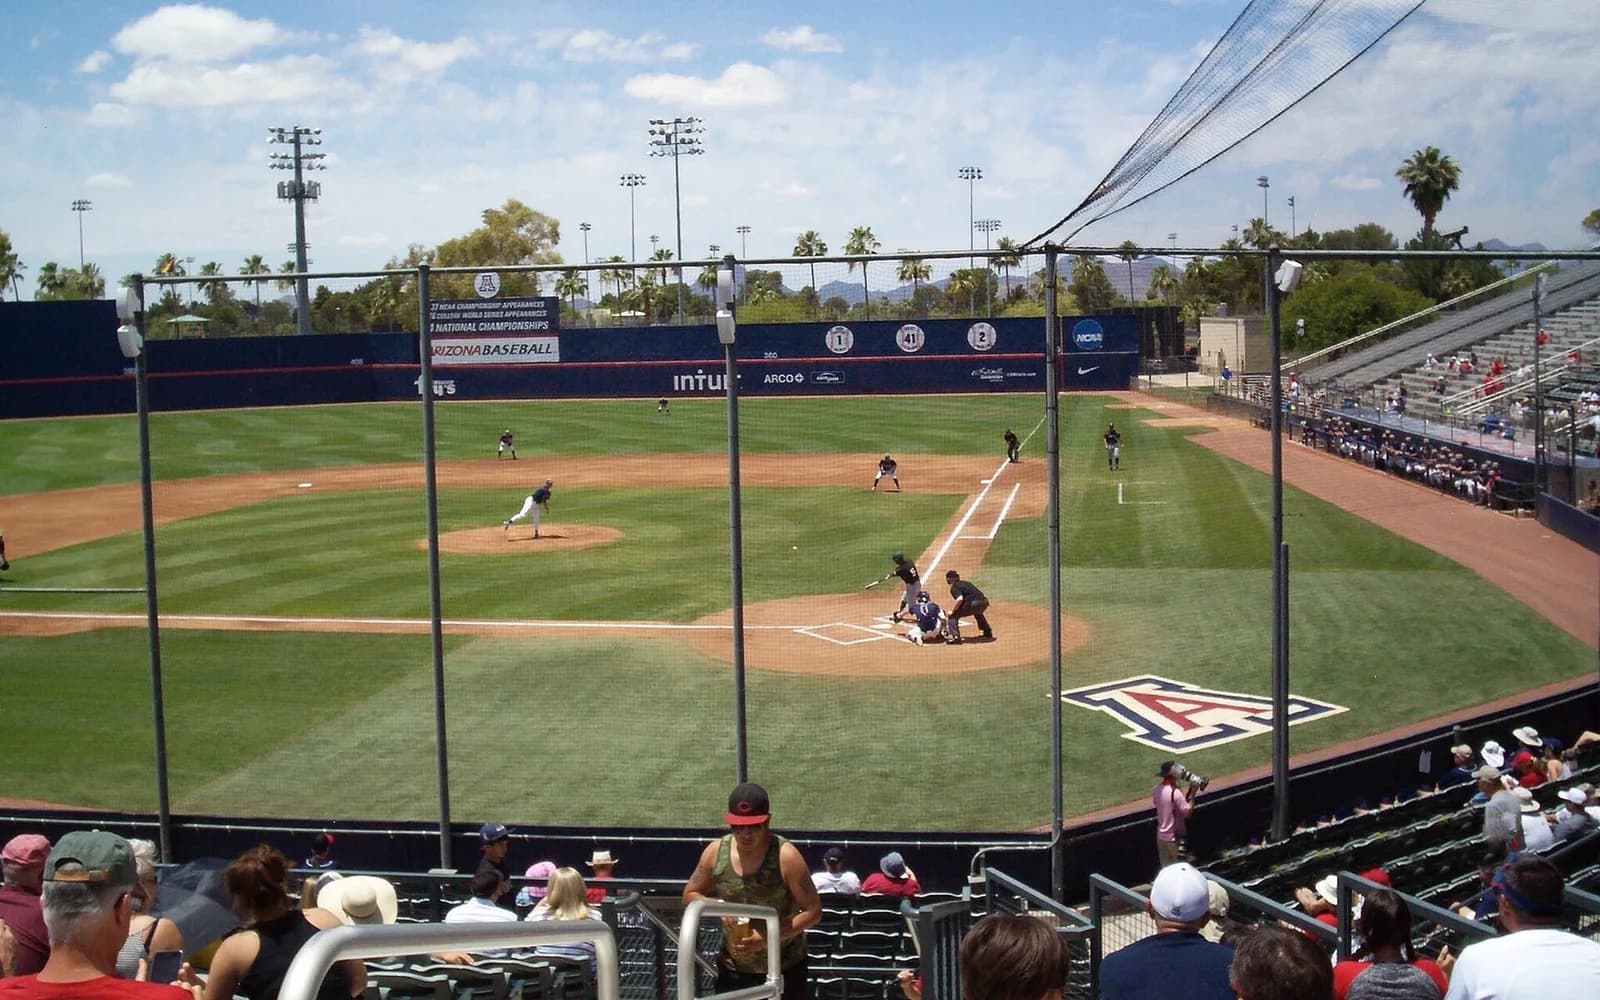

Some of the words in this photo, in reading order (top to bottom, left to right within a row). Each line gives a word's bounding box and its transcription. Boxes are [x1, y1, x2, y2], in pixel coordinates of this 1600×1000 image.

[479, 275, 495, 291] A
[435, 322, 477, 332] NATIONAL
[479, 321, 549, 331] CHAMPIONSHIPS
[904, 333, 916, 344] 41
[482, 343, 552, 356] BASEBALL
[673, 369, 742, 391] intui
[763, 374, 794, 384] ARCO
[1046, 674, 1351, 755] A
